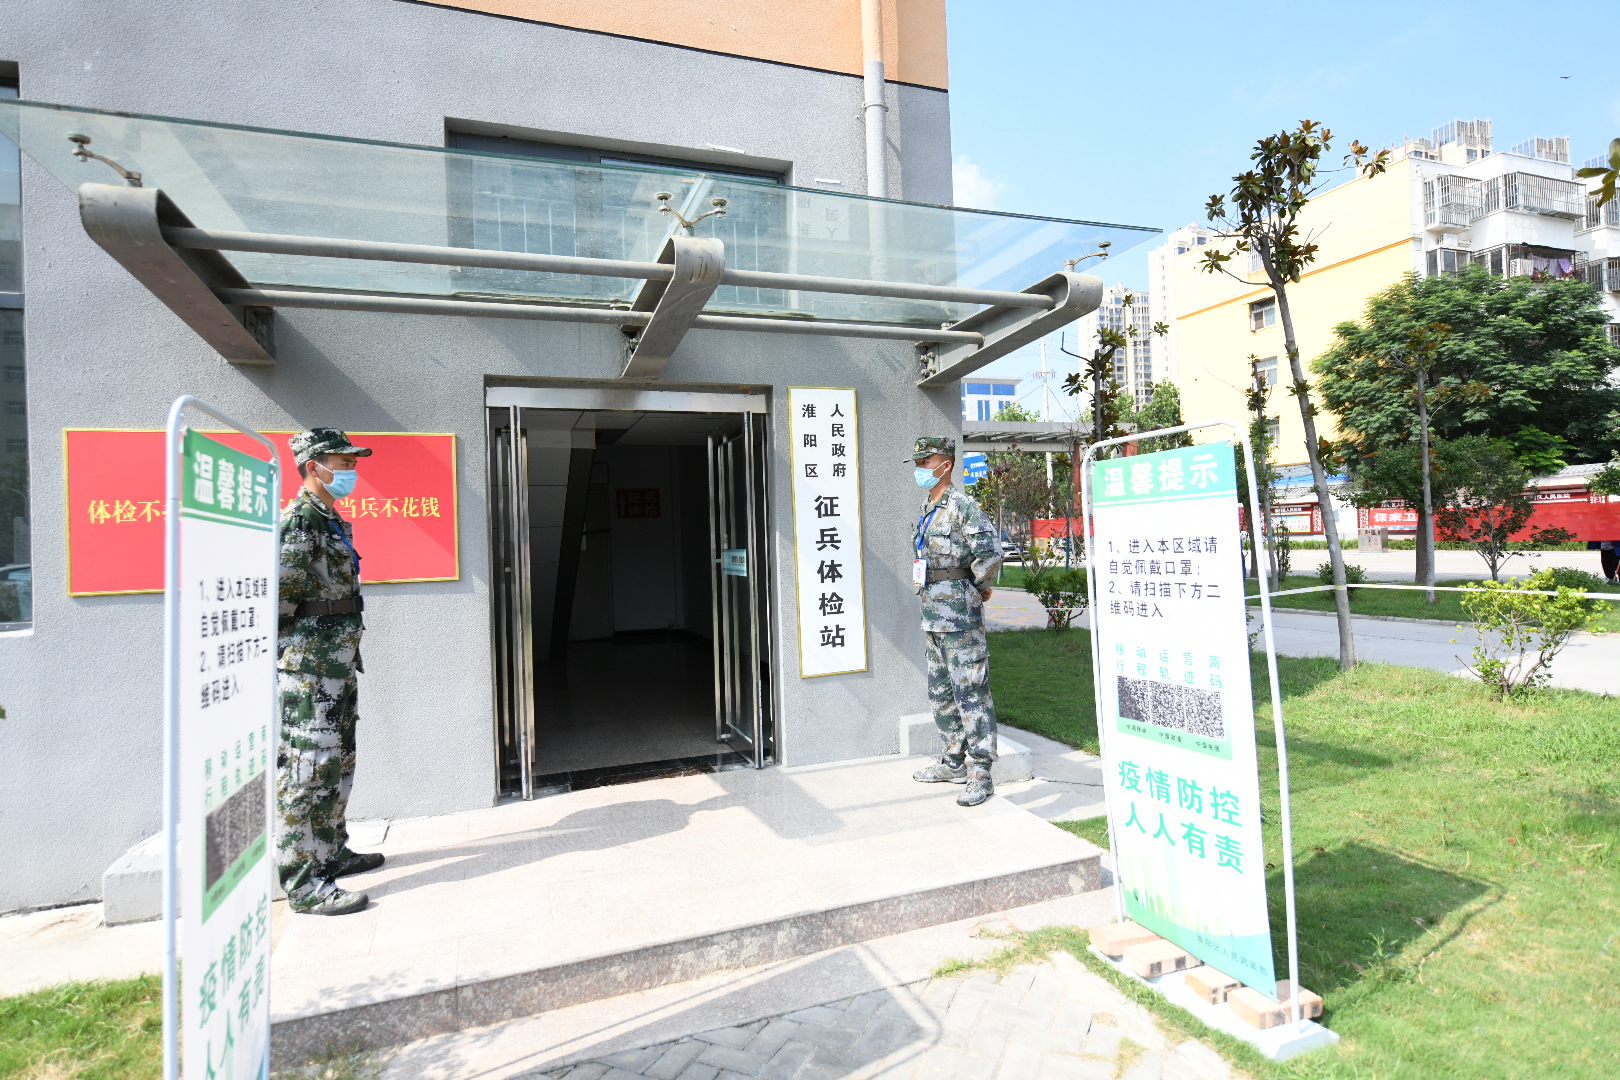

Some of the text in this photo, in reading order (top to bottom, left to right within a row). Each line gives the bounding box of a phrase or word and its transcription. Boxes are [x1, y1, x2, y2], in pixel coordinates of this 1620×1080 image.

[802, 404, 818, 477] 淮阳区
[830, 404, 846, 477] 人民政府
[193, 451, 268, 517] 温馨提示
[339, 497, 441, 518] 当兵不花钱
[627, 492, 657, 503] 征兵
[1104, 454, 1218, 497] 温馨提示
[628, 503, 657, 516] 体检
[814, 495, 845, 648] 征兵体检站
[1115, 643, 1221, 670] 移动运营商
[1116, 660, 1223, 688] 行程轨迹码
[1118, 760, 1242, 827] 疫情防控
[1124, 802, 1245, 875] 人人有责
[199, 892, 267, 1029] 疫情防控
